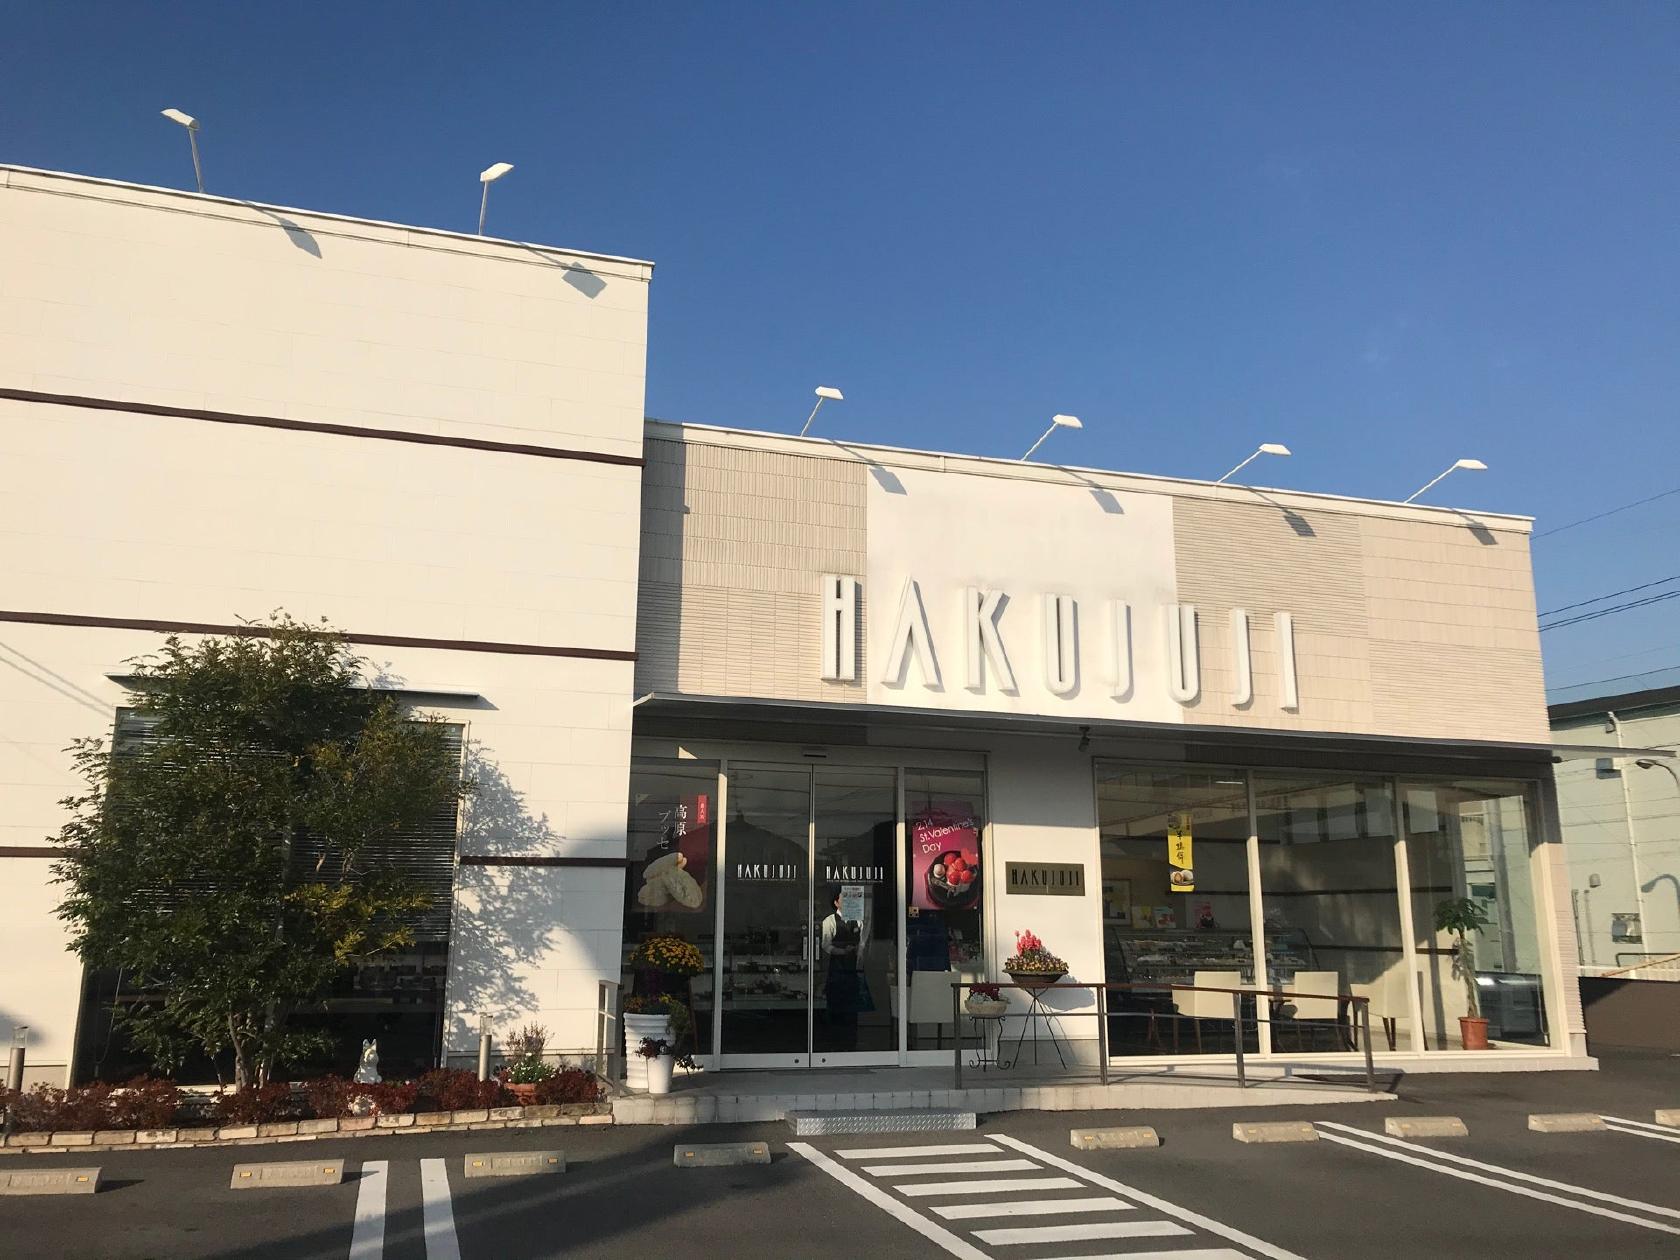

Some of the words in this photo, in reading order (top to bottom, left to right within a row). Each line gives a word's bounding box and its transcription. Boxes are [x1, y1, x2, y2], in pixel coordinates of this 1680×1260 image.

[820, 574, 1299, 712] HAKUJUJI
[672, 803, 688, 838] 高原
[921, 841, 942, 854] Day
[737, 864, 797, 879] HAKUJUJI
[826, 865, 884, 880] HAKUJUJI
[1011, 868, 1080, 886] HAKUJUJI
